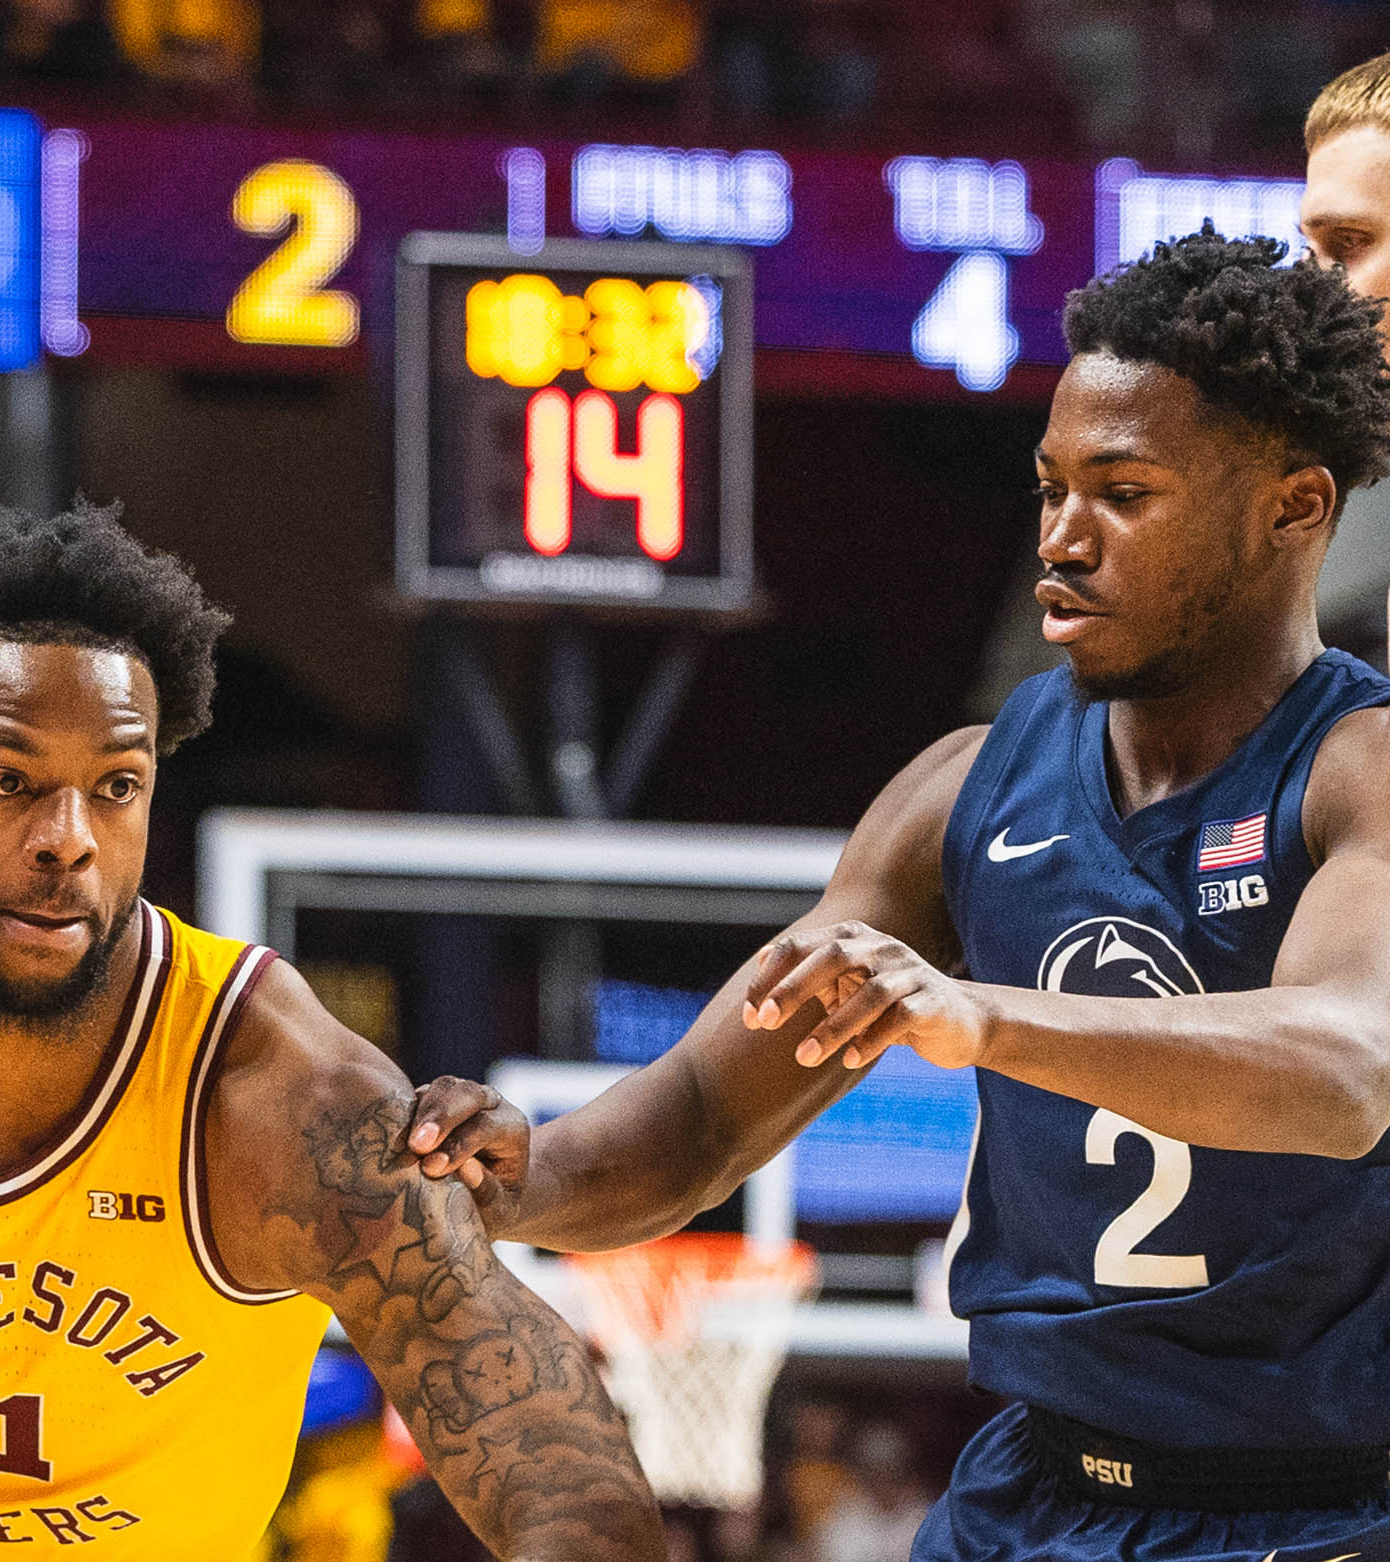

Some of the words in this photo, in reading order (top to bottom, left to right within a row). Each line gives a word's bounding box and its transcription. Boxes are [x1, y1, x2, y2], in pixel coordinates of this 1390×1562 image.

[225, 158, 360, 346] 2
[912, 251, 1020, 392] 4
[523, 386, 684, 561] 14
[1085, 1107, 1210, 1288] 2
[1082, 1453, 1133, 1488] PSU
